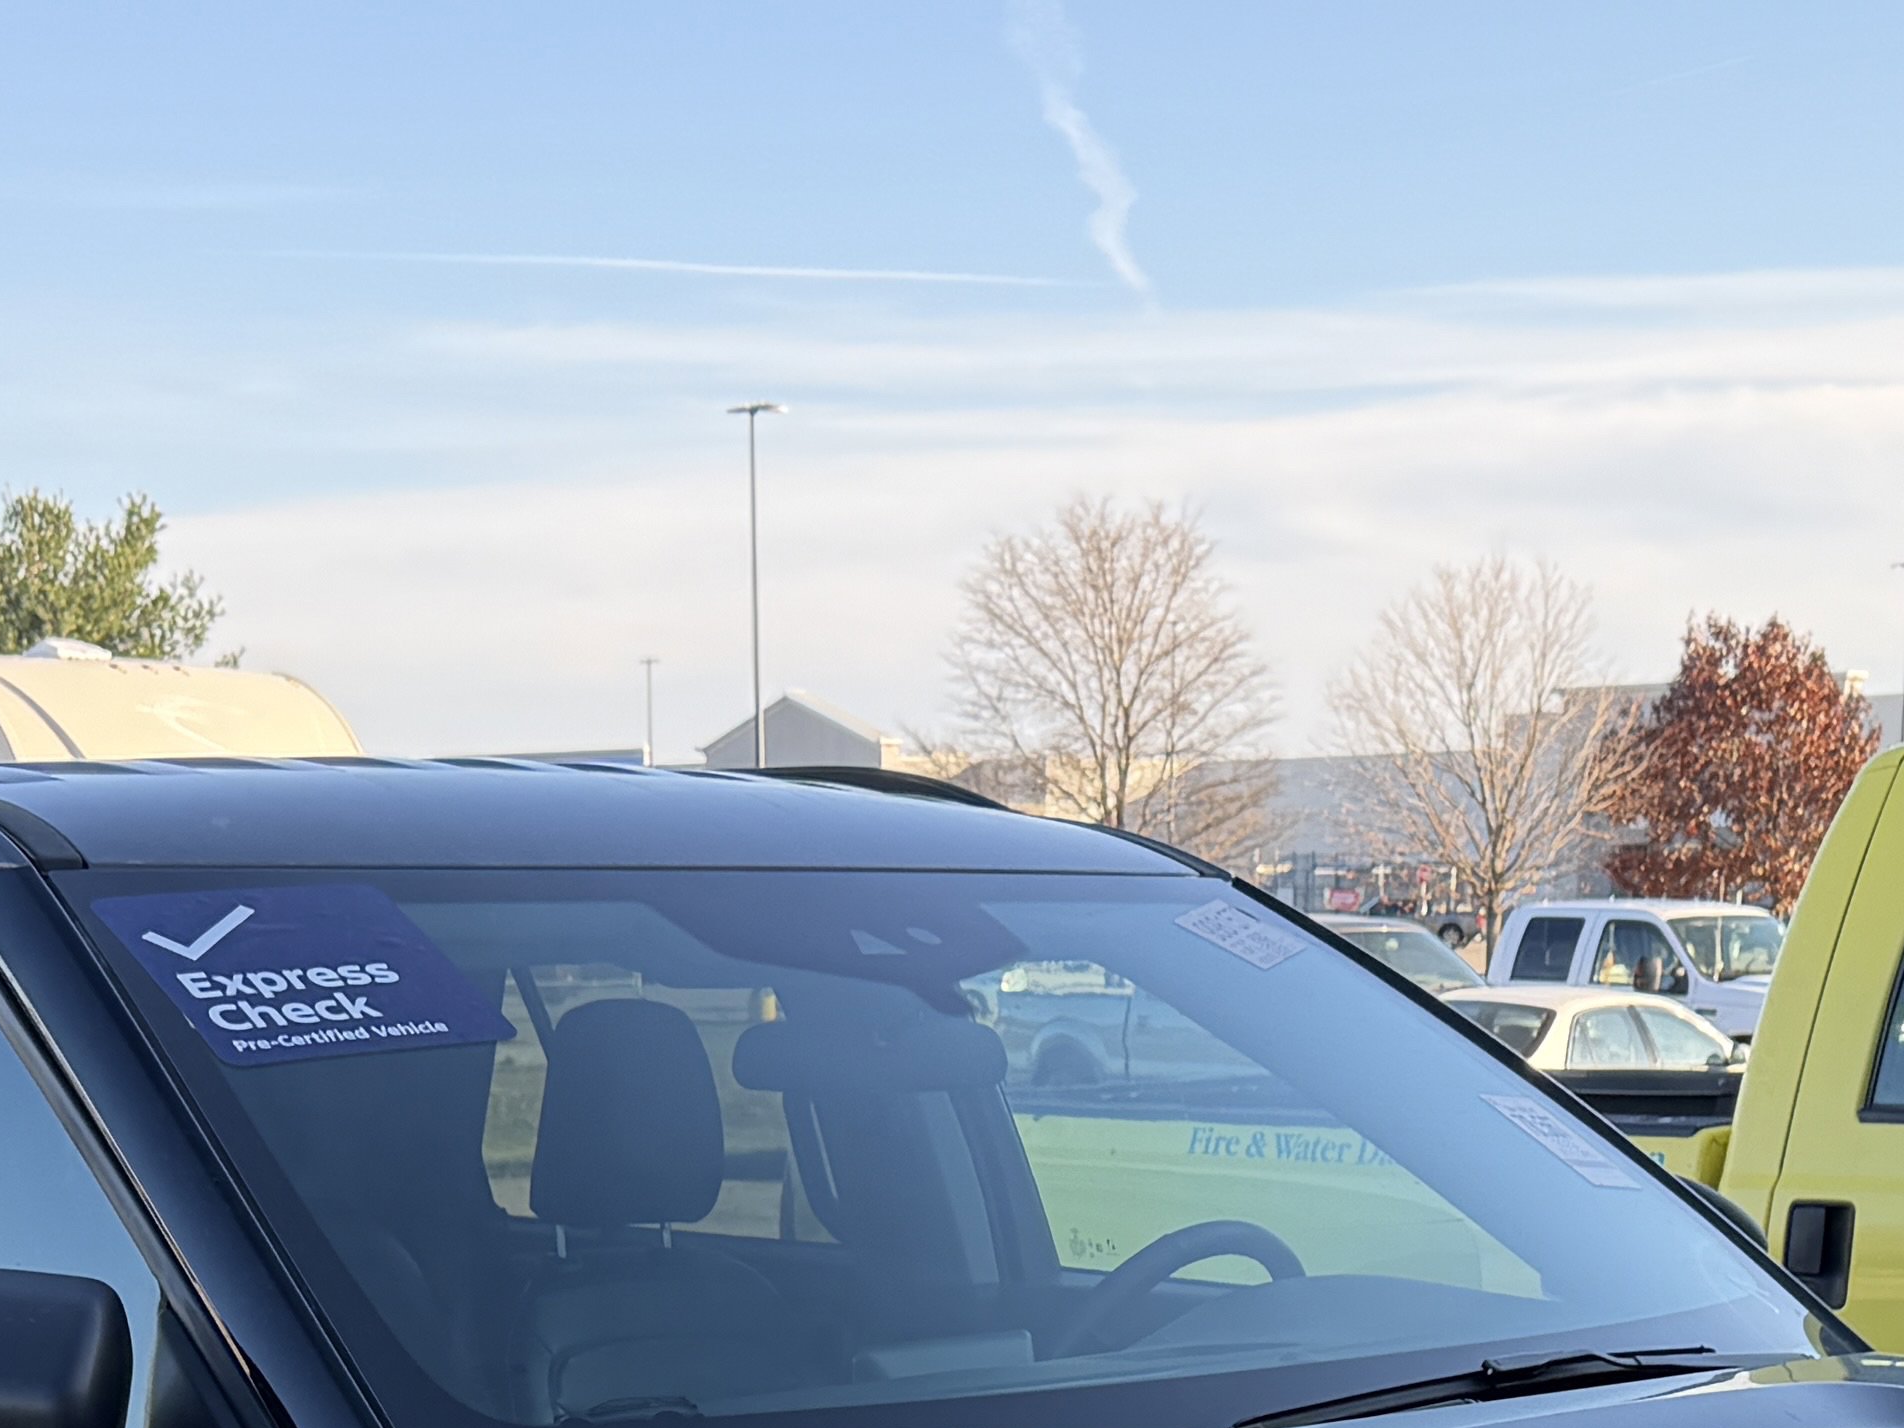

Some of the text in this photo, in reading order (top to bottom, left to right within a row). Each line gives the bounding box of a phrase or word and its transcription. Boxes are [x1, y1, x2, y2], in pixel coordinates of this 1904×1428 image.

[176, 962, 400, 999] Express
[208, 991, 383, 1031] Check
[232, 1020, 449, 1053] Pre-Certified Vehicle
[1188, 1127, 1239, 1156] Fire
[1245, 1131, 1265, 1157] &
[1275, 1133, 1351, 1163] Water
